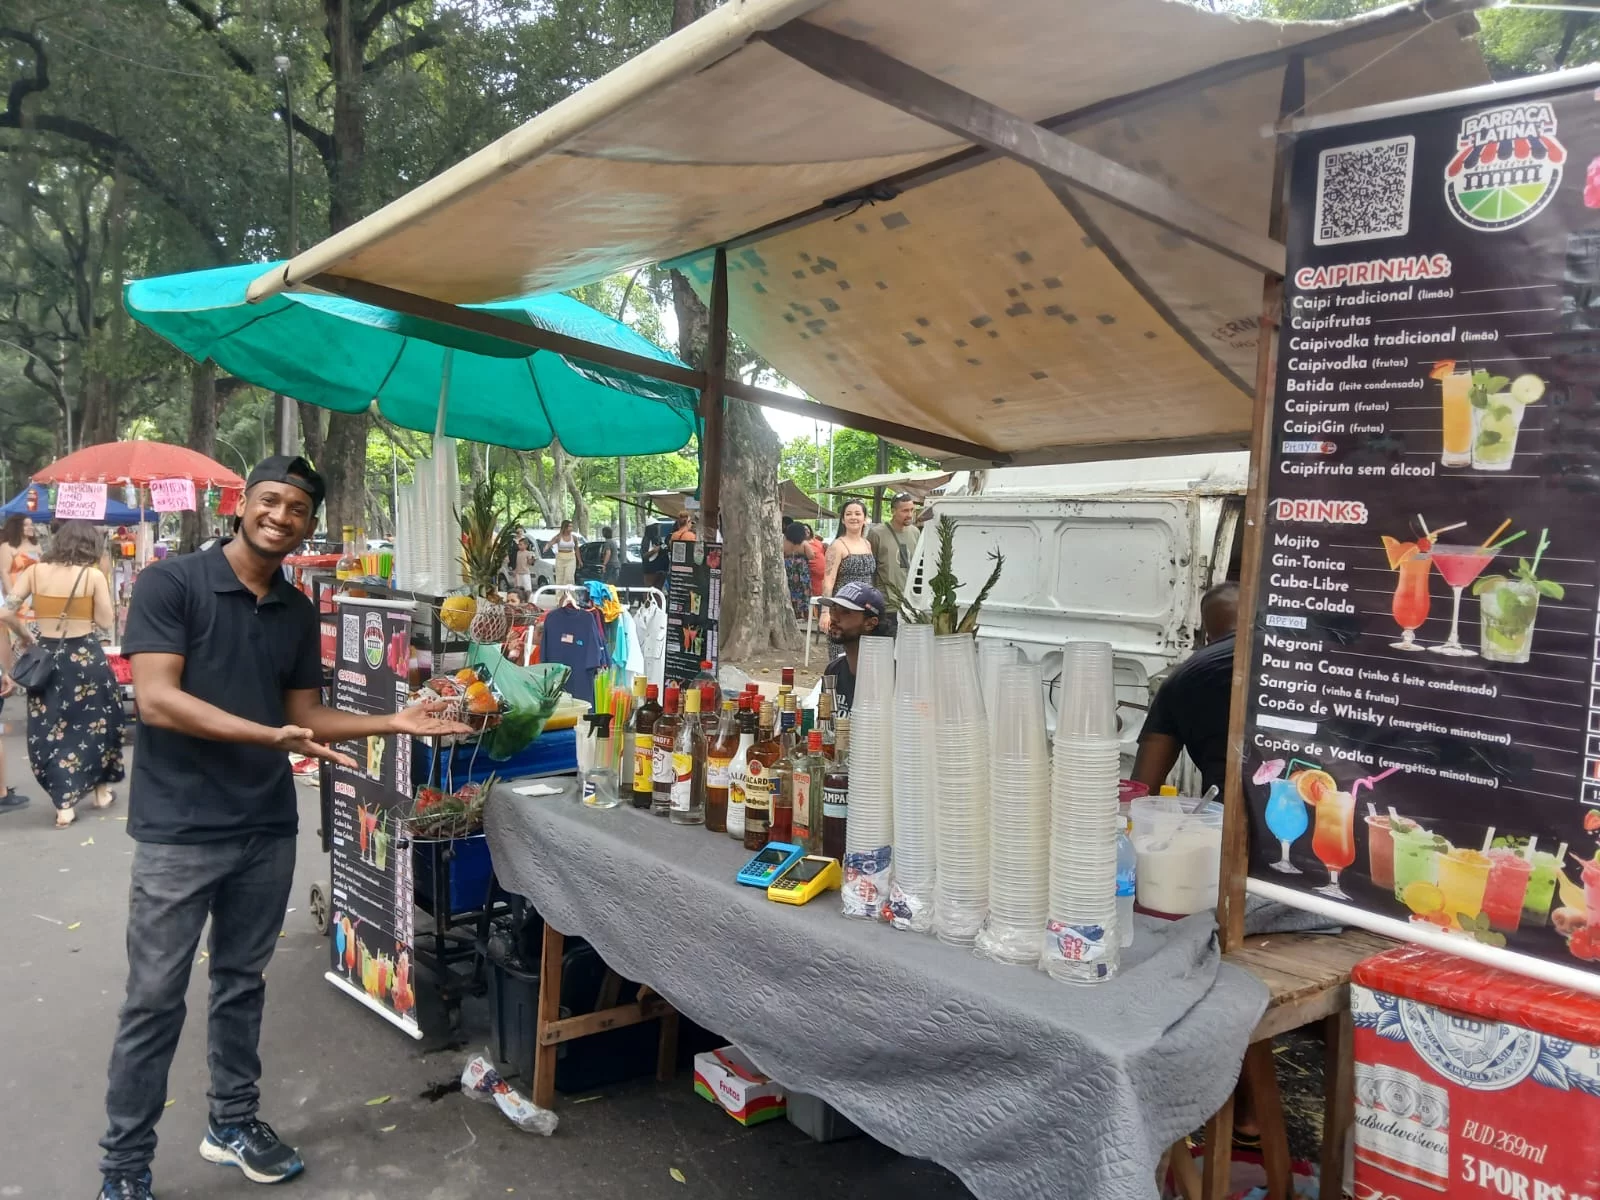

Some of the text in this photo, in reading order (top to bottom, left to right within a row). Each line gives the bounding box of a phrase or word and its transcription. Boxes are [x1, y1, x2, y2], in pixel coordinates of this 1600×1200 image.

[1465, 106, 1551, 136] BARRACA
[1475, 122, 1538, 147] LATINA
[1292, 285, 1454, 311] Caipi tradicional (limão)
[1291, 314, 1372, 332] Caipifrutas
[1289, 327, 1499, 353] Caipivodka tradicional (limão)
[1287, 355, 1409, 374] Caipivodka (frutas)
[1286, 377, 1424, 392] Batida (leite condensado)
[1284, 398, 1390, 416] Caipirum (frutas)
[1283, 419, 1385, 435] CaipiGin (frutas)
[1280, 460, 1436, 477] Caipifruta sem álcool
[1273, 533, 1320, 550] Mojito
[1271, 553, 1346, 571] Gin-Tonica
[1269, 574, 1350, 592] Cuba-Libre
[1267, 593, 1355, 614] Pina-Colada
[1263, 634, 1324, 652] Negroni
[1261, 654, 1498, 699] Pau na Coxa (vinho & leite condensado)
[1259, 674, 1400, 706] Sangria (vinho & frutas)
[1257, 694, 1512, 746] Copão de Whisky (energético minotauro)
[1254, 733, 1499, 789] Copão de Vodka (energético minotauro)
[719, 1079, 741, 1102] Frutas
[1461, 1119, 1548, 1164] BUD 269ml
[1461, 1153, 1476, 1182] 3
[1478, 1159, 1529, 1200] POR
